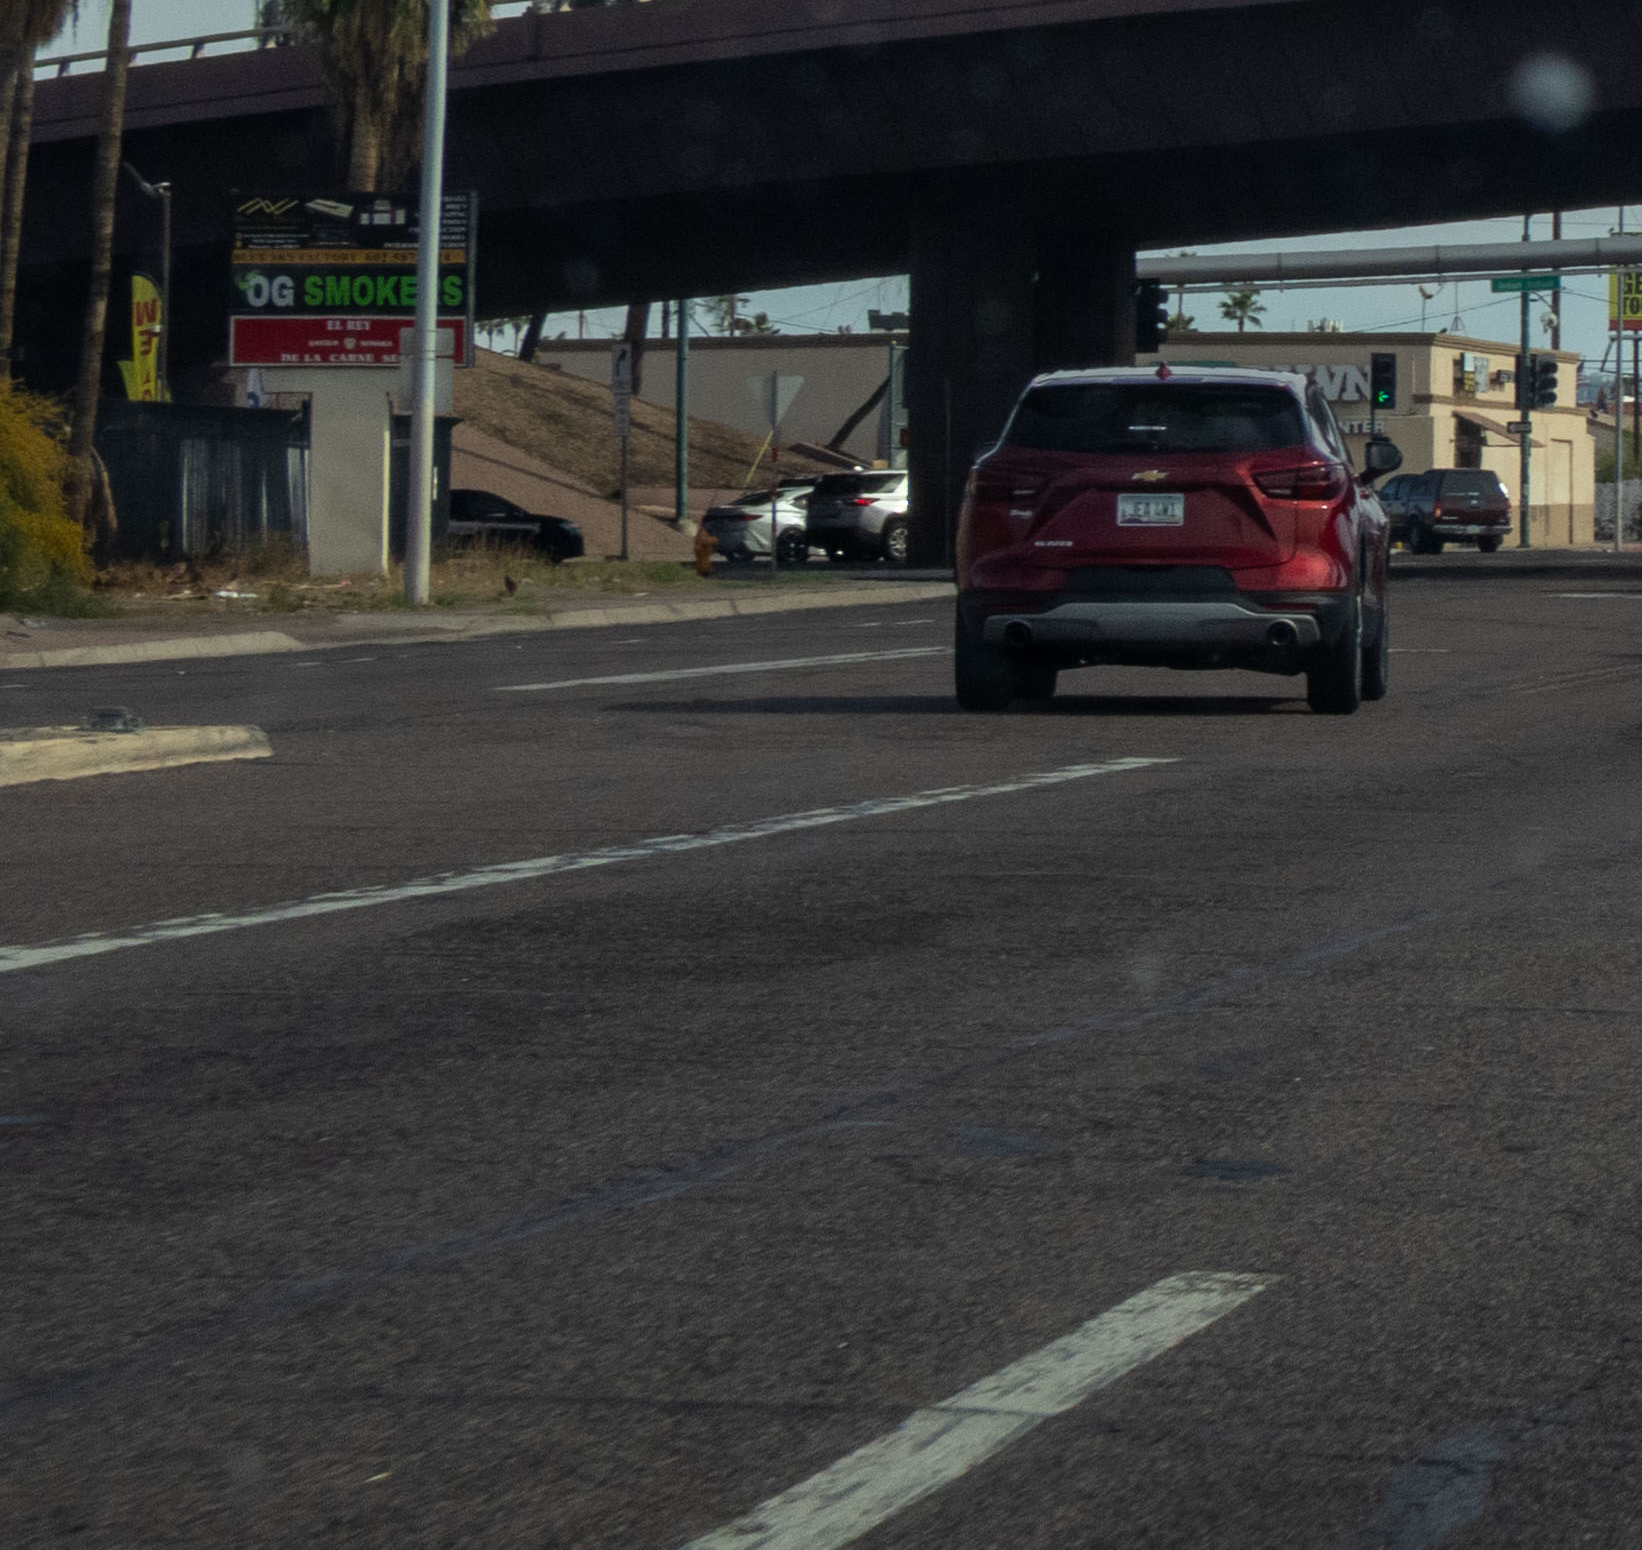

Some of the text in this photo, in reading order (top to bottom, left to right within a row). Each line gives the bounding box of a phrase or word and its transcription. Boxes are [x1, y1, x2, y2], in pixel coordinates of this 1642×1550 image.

[247, 275, 463, 307] OG SMOKES
[326, 320, 372, 331] EL REY
[280, 353, 301, 363] DE
[304, 353, 322, 363] LA
[329, 353, 376, 363] CARNE
